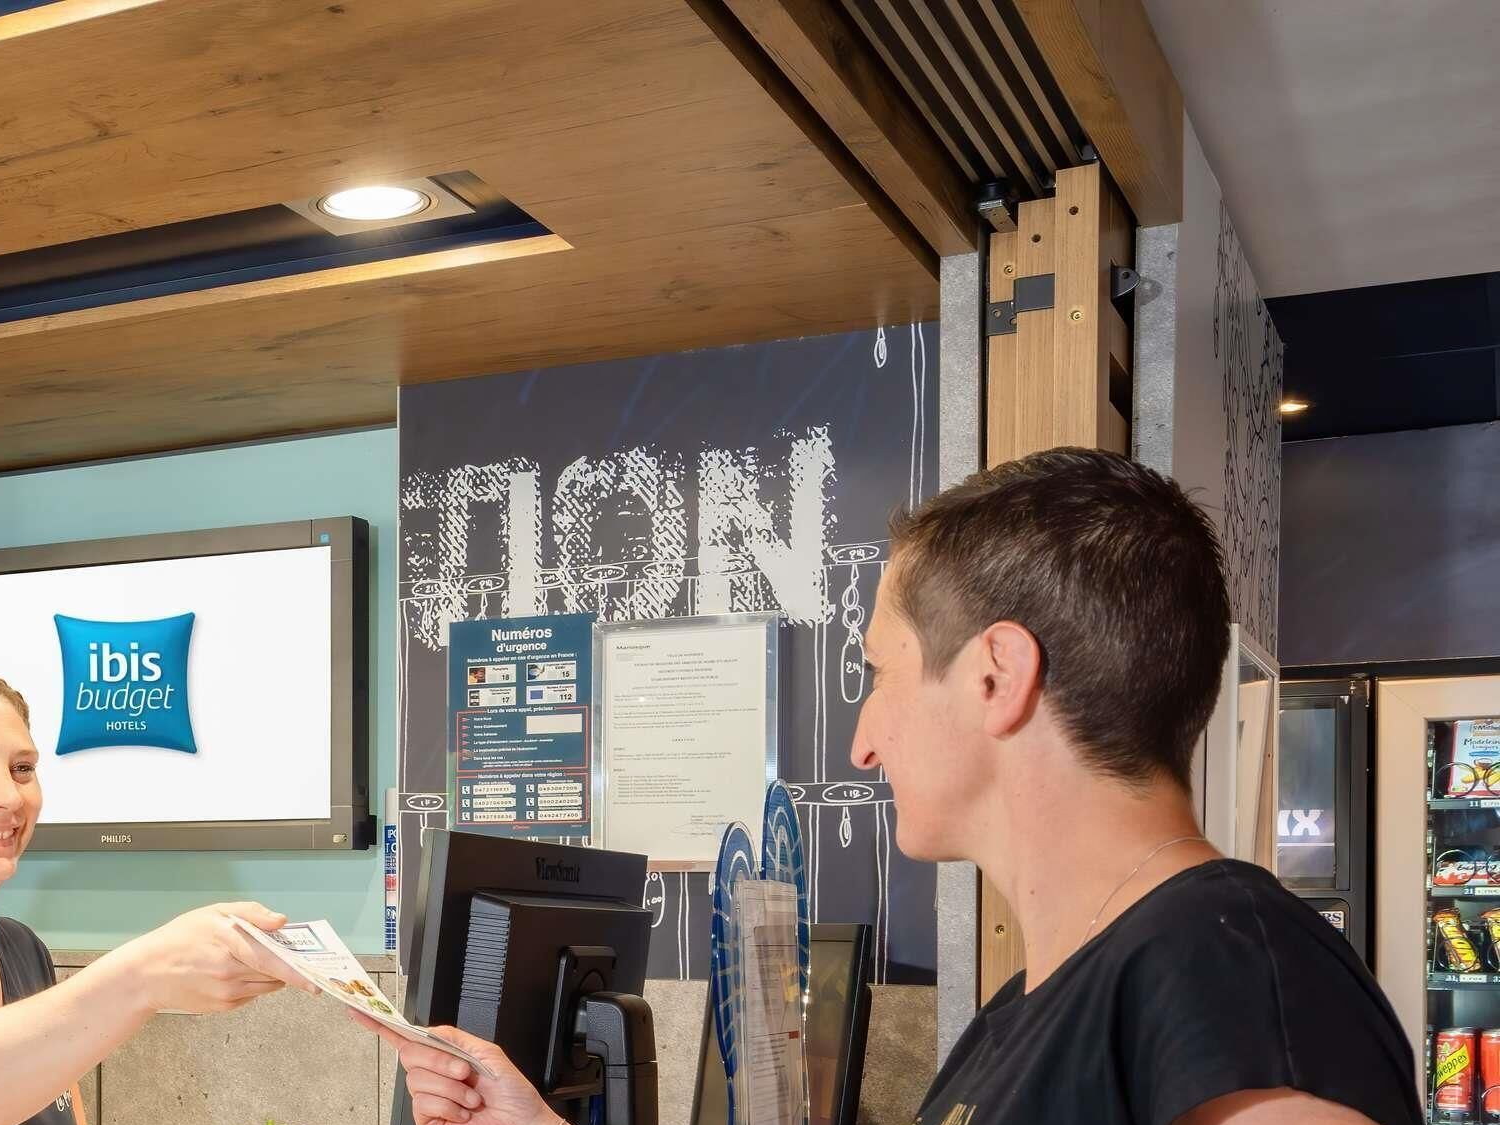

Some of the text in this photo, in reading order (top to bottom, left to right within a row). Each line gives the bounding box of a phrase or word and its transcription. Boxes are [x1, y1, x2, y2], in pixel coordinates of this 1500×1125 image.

[491, 627, 553, 641] Numéros
[496, 642, 547, 654] d'urgence
[89, 642, 162, 682] ibis
[76, 682, 174, 716] budget
[106, 721, 146, 730] HOTELS
[101, 834, 132, 843] PHILIPS
